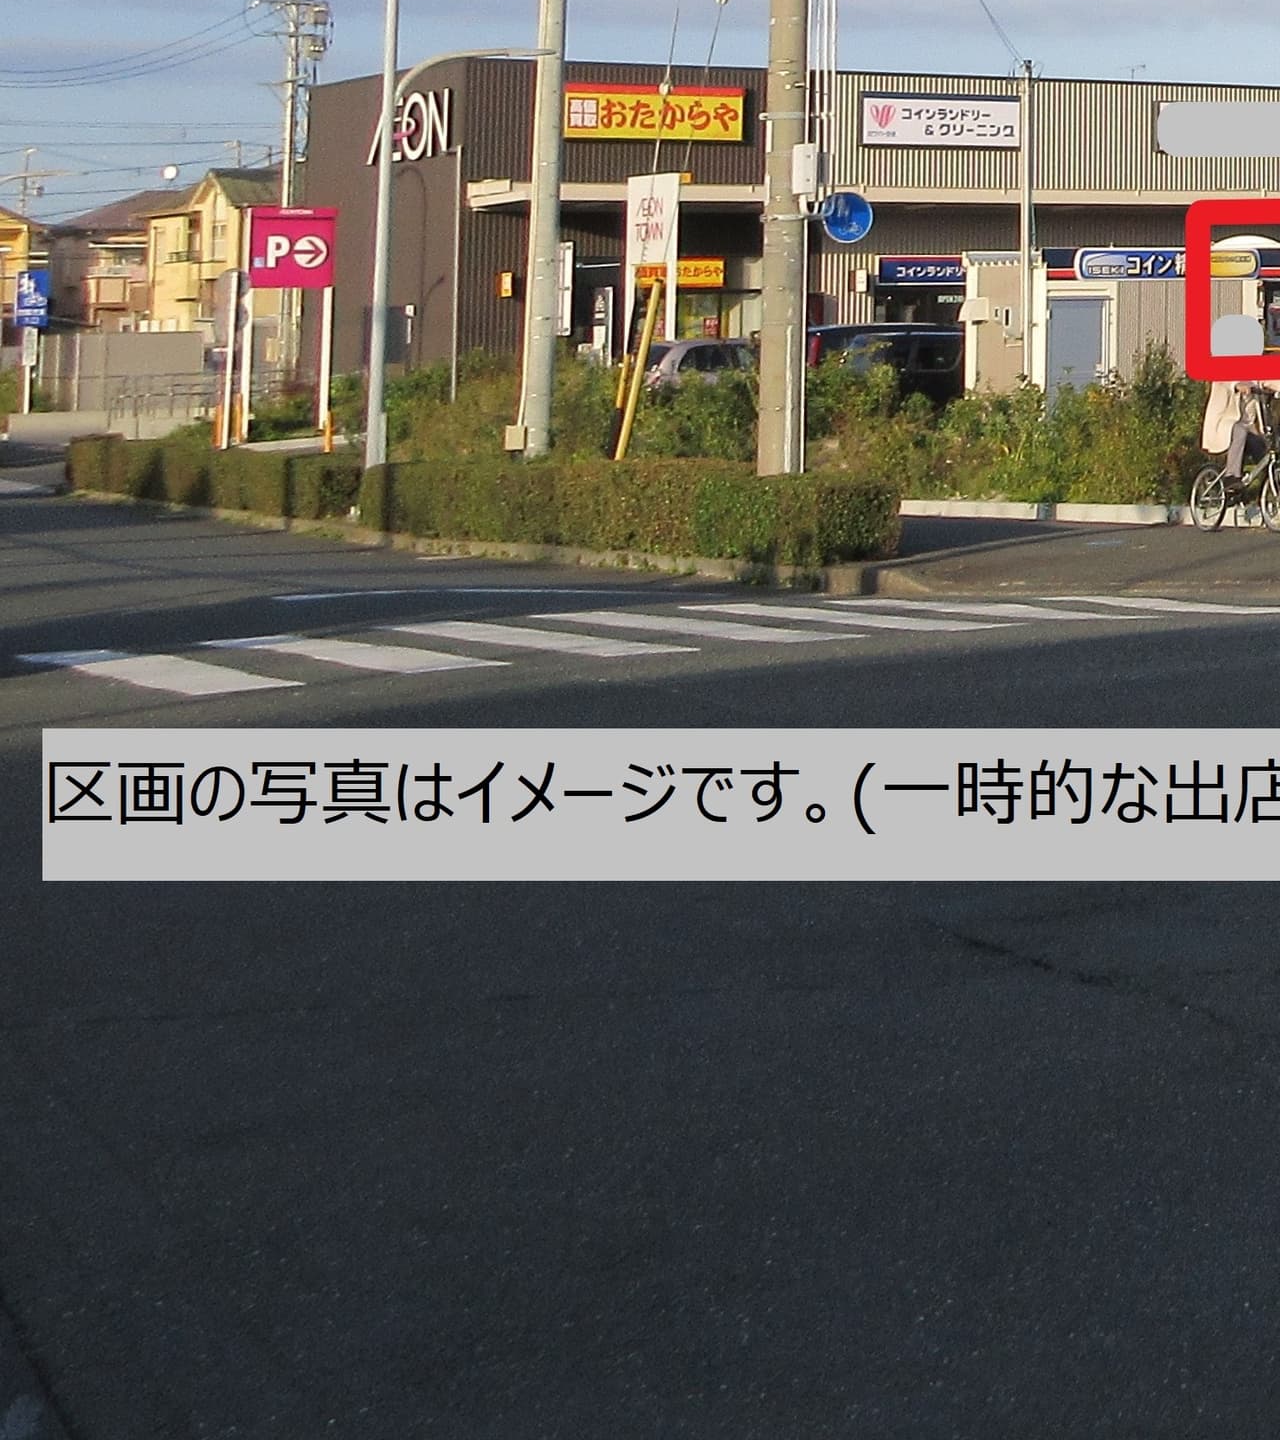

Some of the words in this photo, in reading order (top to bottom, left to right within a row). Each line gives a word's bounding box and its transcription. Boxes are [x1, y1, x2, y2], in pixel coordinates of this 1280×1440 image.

[600, 98, 739, 132] おたからや
[901, 108, 991, 121] コインランドリー
[924, 124, 935, 136] &
[266, 235, 290, 268] P
